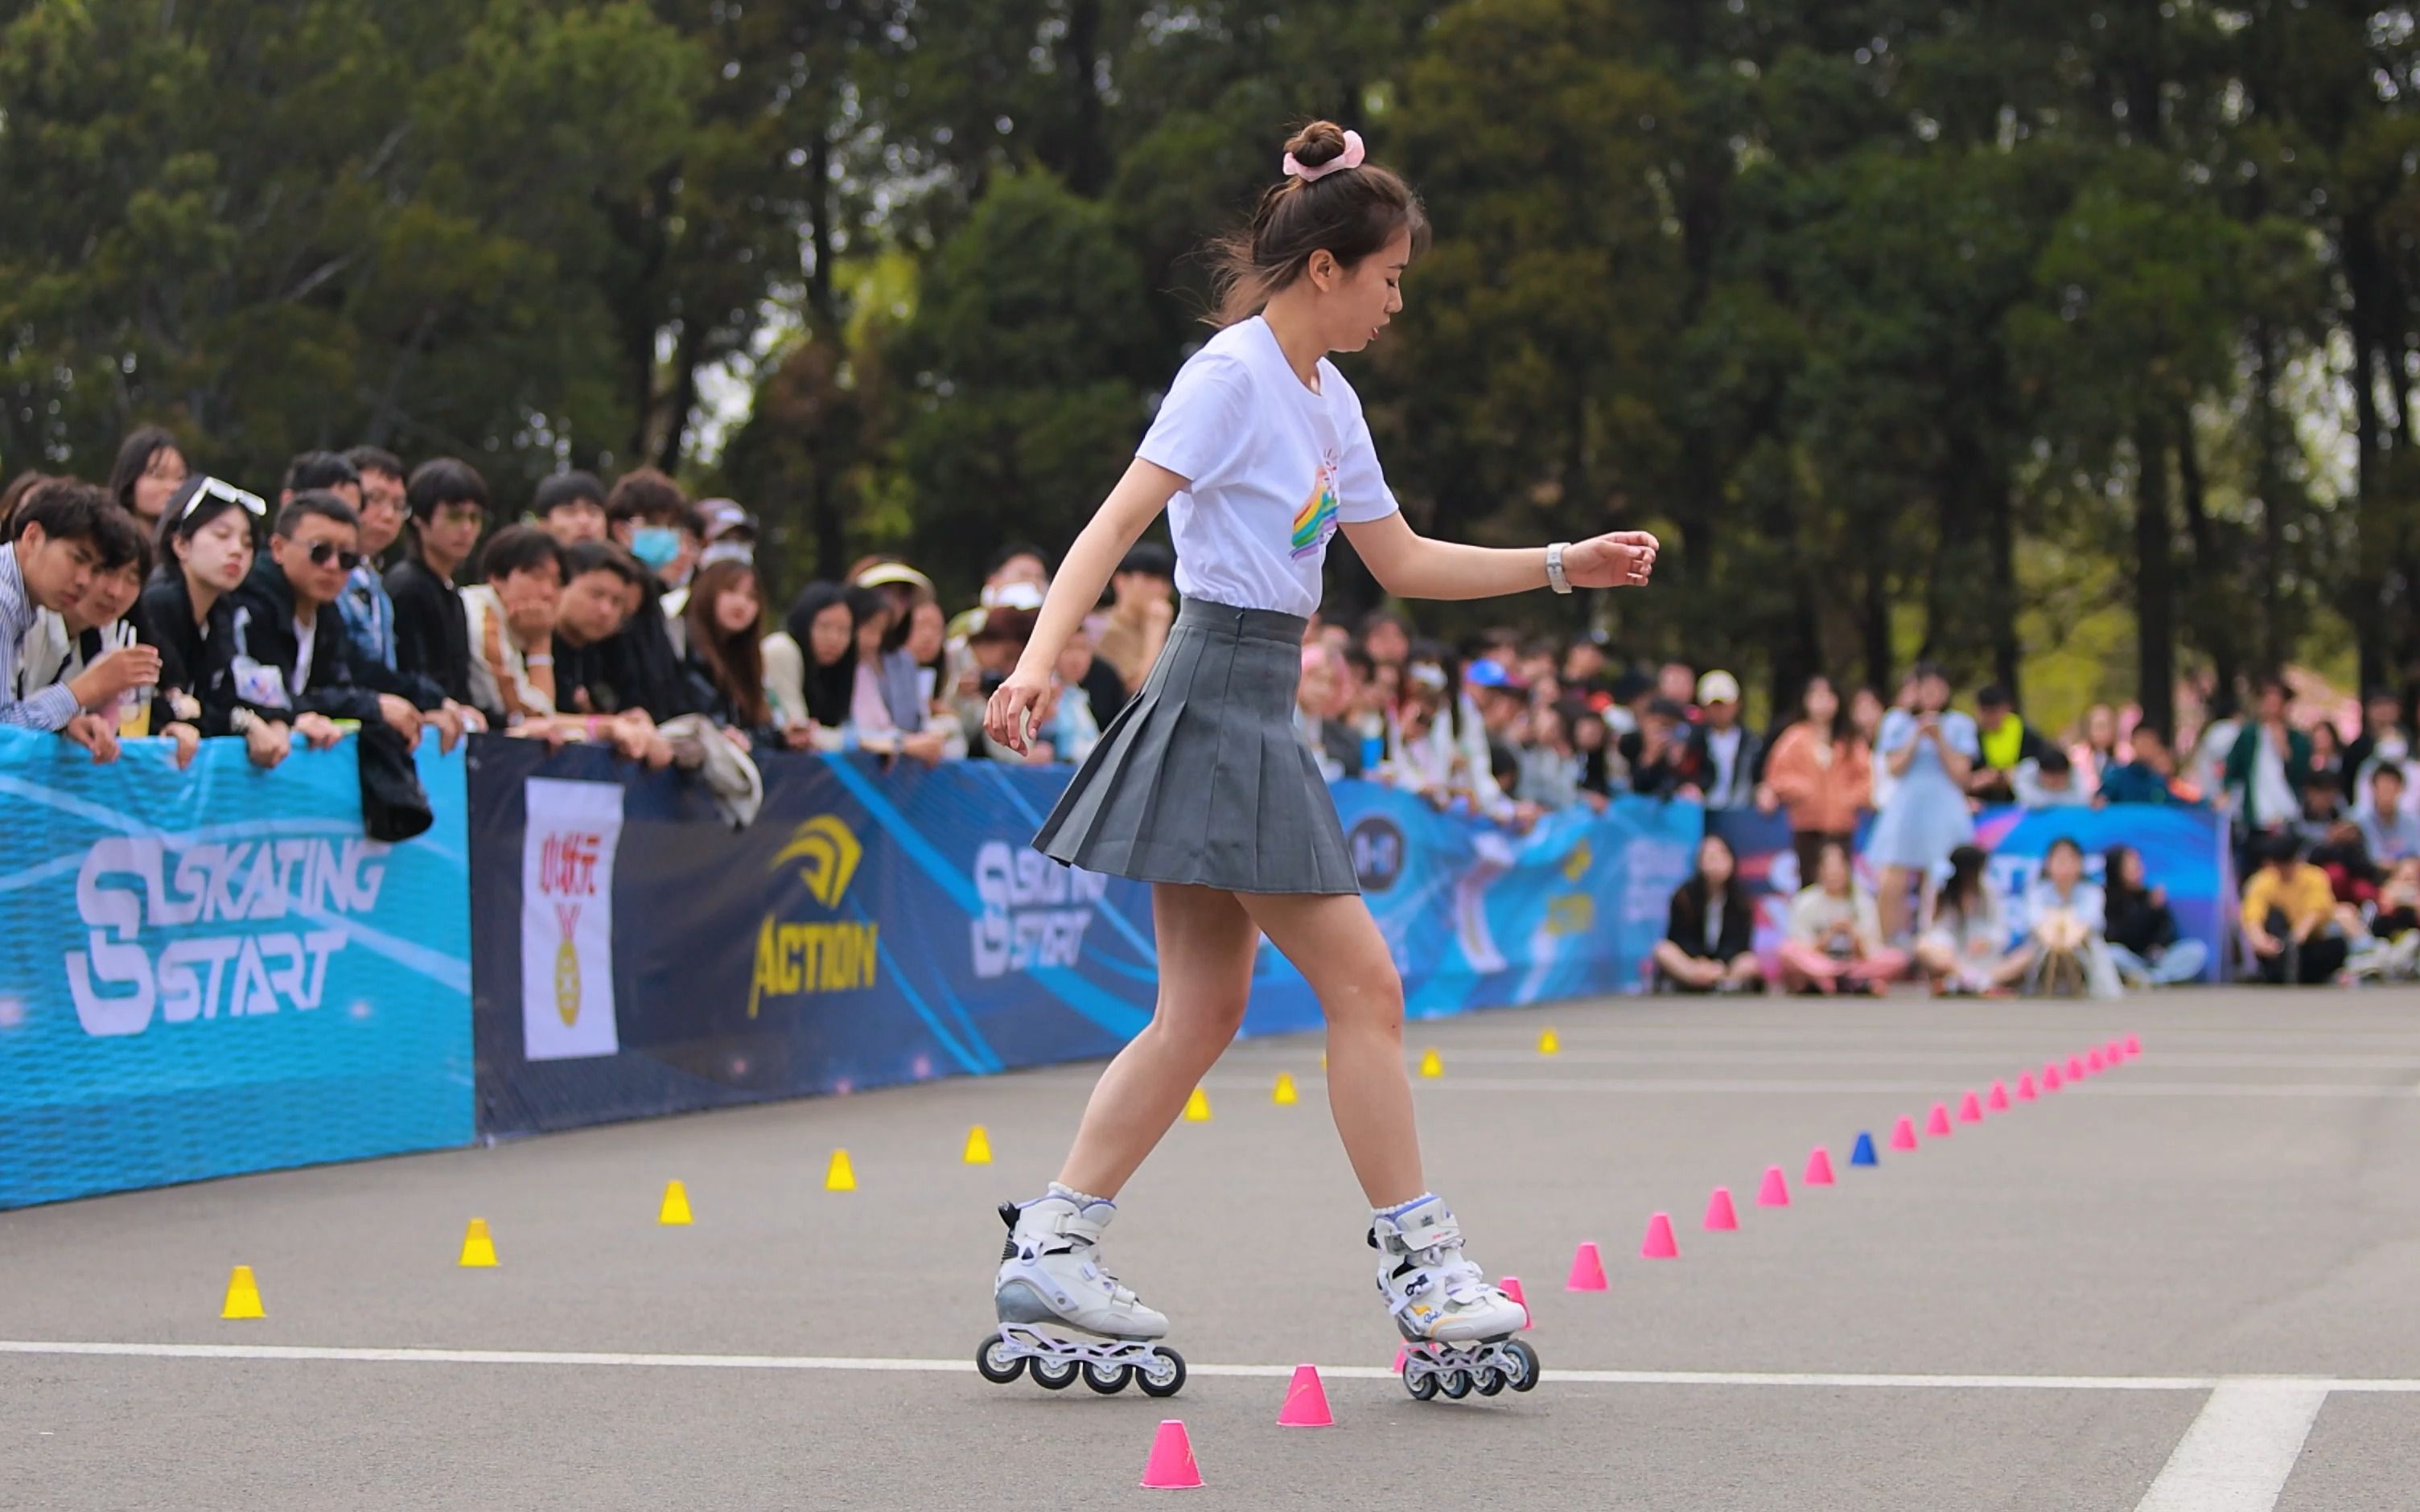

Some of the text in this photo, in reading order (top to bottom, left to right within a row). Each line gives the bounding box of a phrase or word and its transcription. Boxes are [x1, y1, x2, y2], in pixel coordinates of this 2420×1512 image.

[163, 838, 393, 925] SKATING
[159, 929, 348, 1023] START
[747, 911, 879, 1020] ACTION
